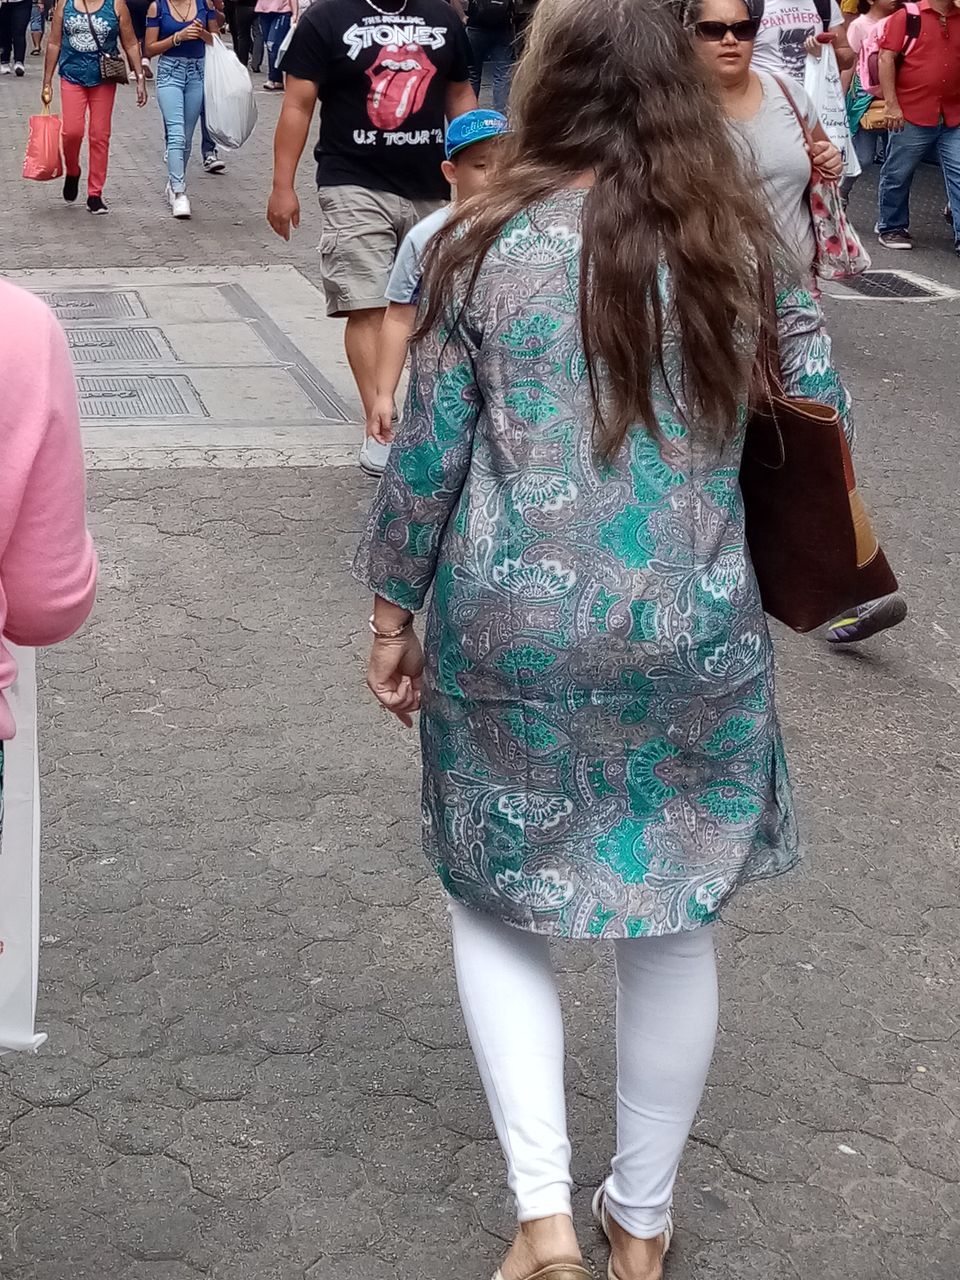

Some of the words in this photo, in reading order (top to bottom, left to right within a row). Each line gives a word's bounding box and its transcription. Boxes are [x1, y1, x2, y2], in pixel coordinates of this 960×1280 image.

[761, 13, 820, 26] PANTHERS
[343, 23, 447, 60] STONES
[383, 130, 429, 146] TOUR
